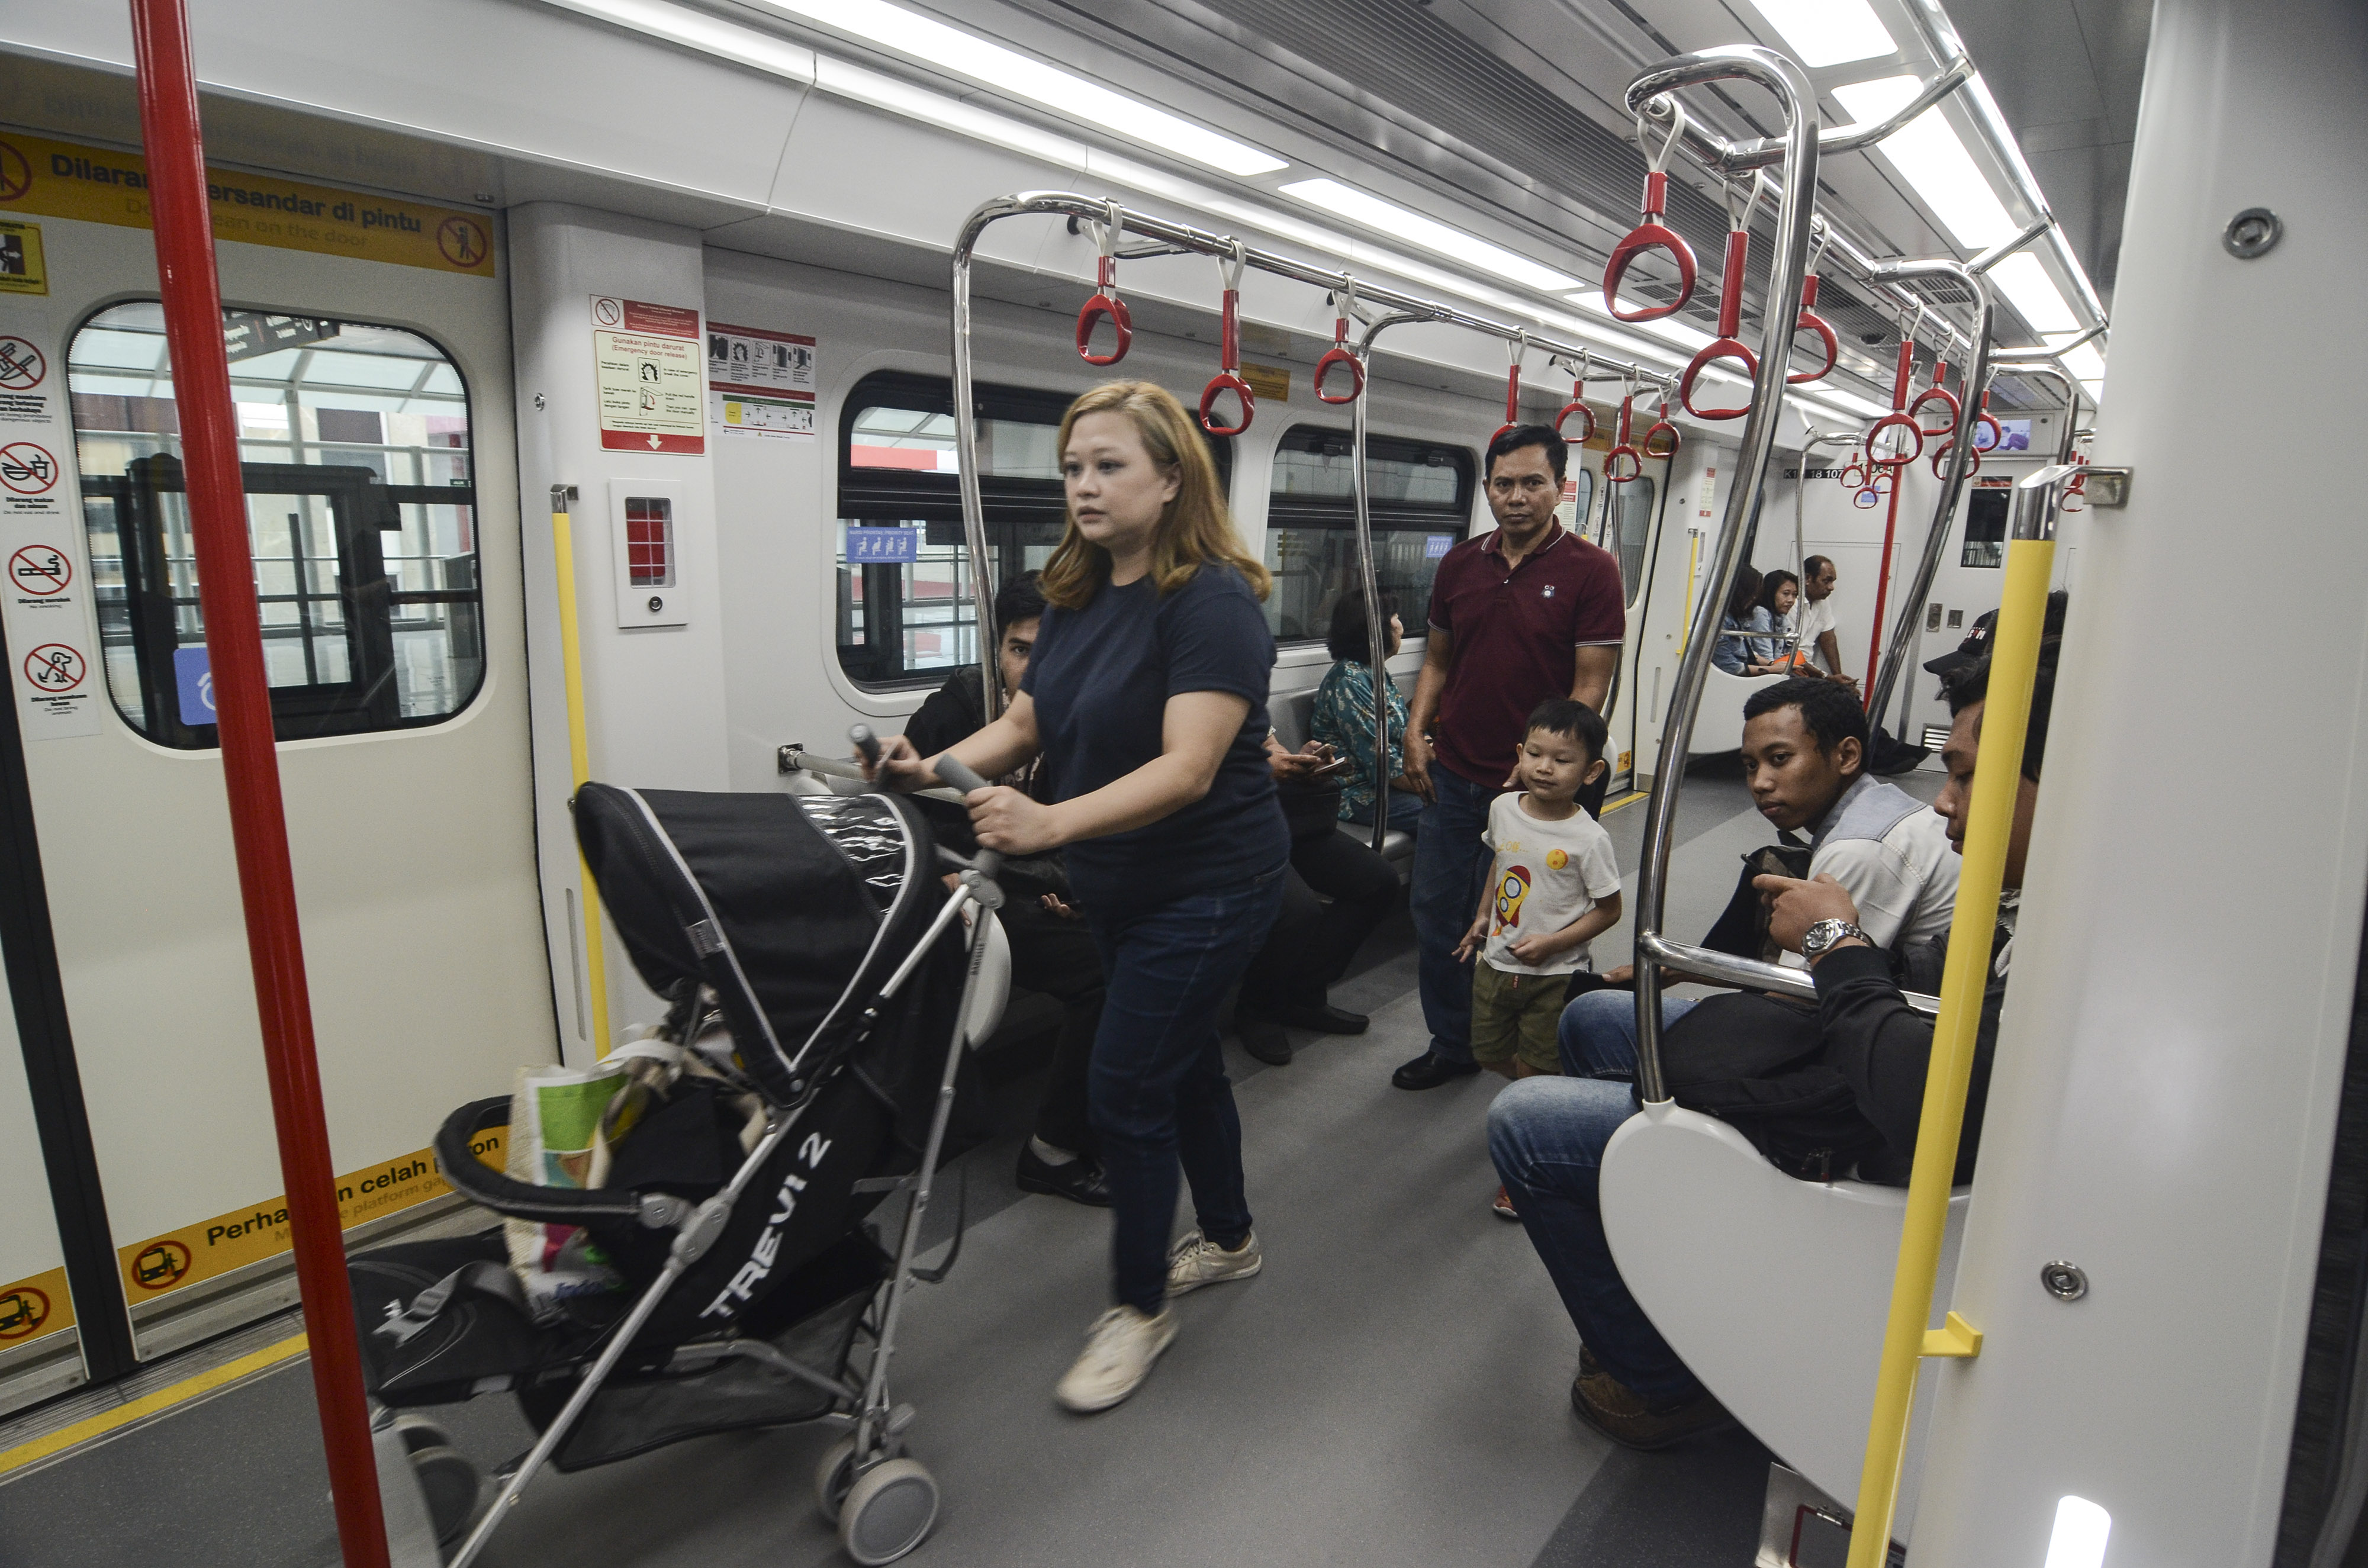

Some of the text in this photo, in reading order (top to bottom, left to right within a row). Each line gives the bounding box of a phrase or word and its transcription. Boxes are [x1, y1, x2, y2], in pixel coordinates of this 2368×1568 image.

[51, 153, 422, 233] Dilara ersandar di pintu
[256, 221, 280, 233] on
[287, 223, 318, 240] the
[324, 231, 369, 247] door
[612, 336, 641, 346] Gunakan
[662, 343, 684, 351] darurat
[612, 344, 648, 355] (Emergency
[665, 351, 687, 360] release)
[1859, 462, 1893, 473] 106A
[360, 1160, 427, 1194] celah
[353, 1186, 419, 1214] platform
[698, 1132, 832, 1319] TREVI 2
